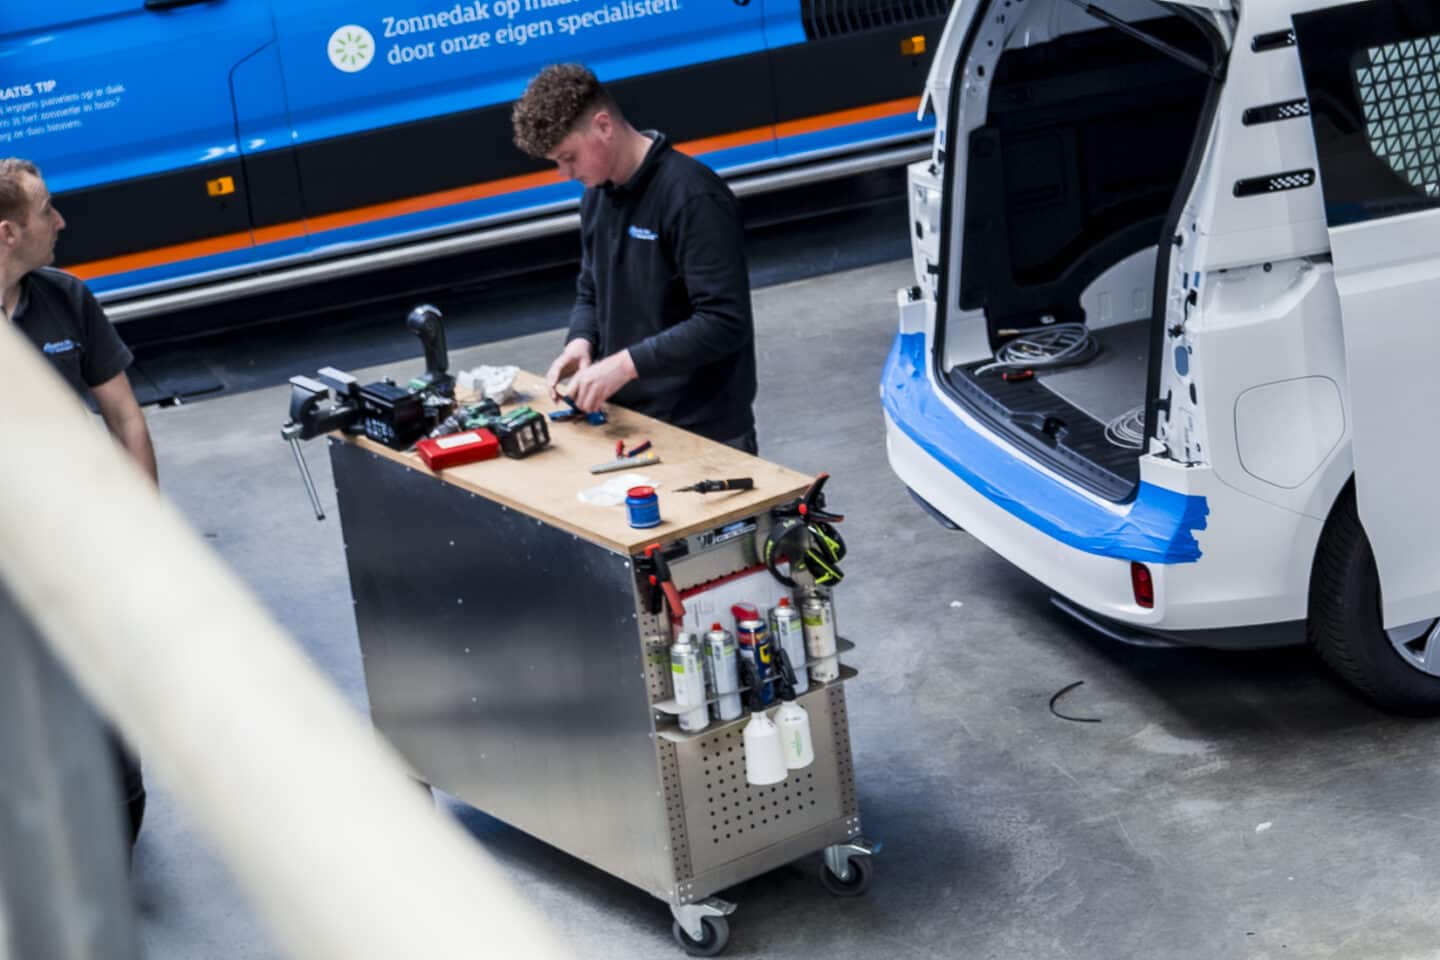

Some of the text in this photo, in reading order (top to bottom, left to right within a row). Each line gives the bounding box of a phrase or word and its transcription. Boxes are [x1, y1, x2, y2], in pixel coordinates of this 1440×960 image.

[382, 0, 520, 37] Zonnedak op
[387, 42, 435, 65] door
[441, 32, 491, 55] onze
[495, 19, 554, 46] eigen
